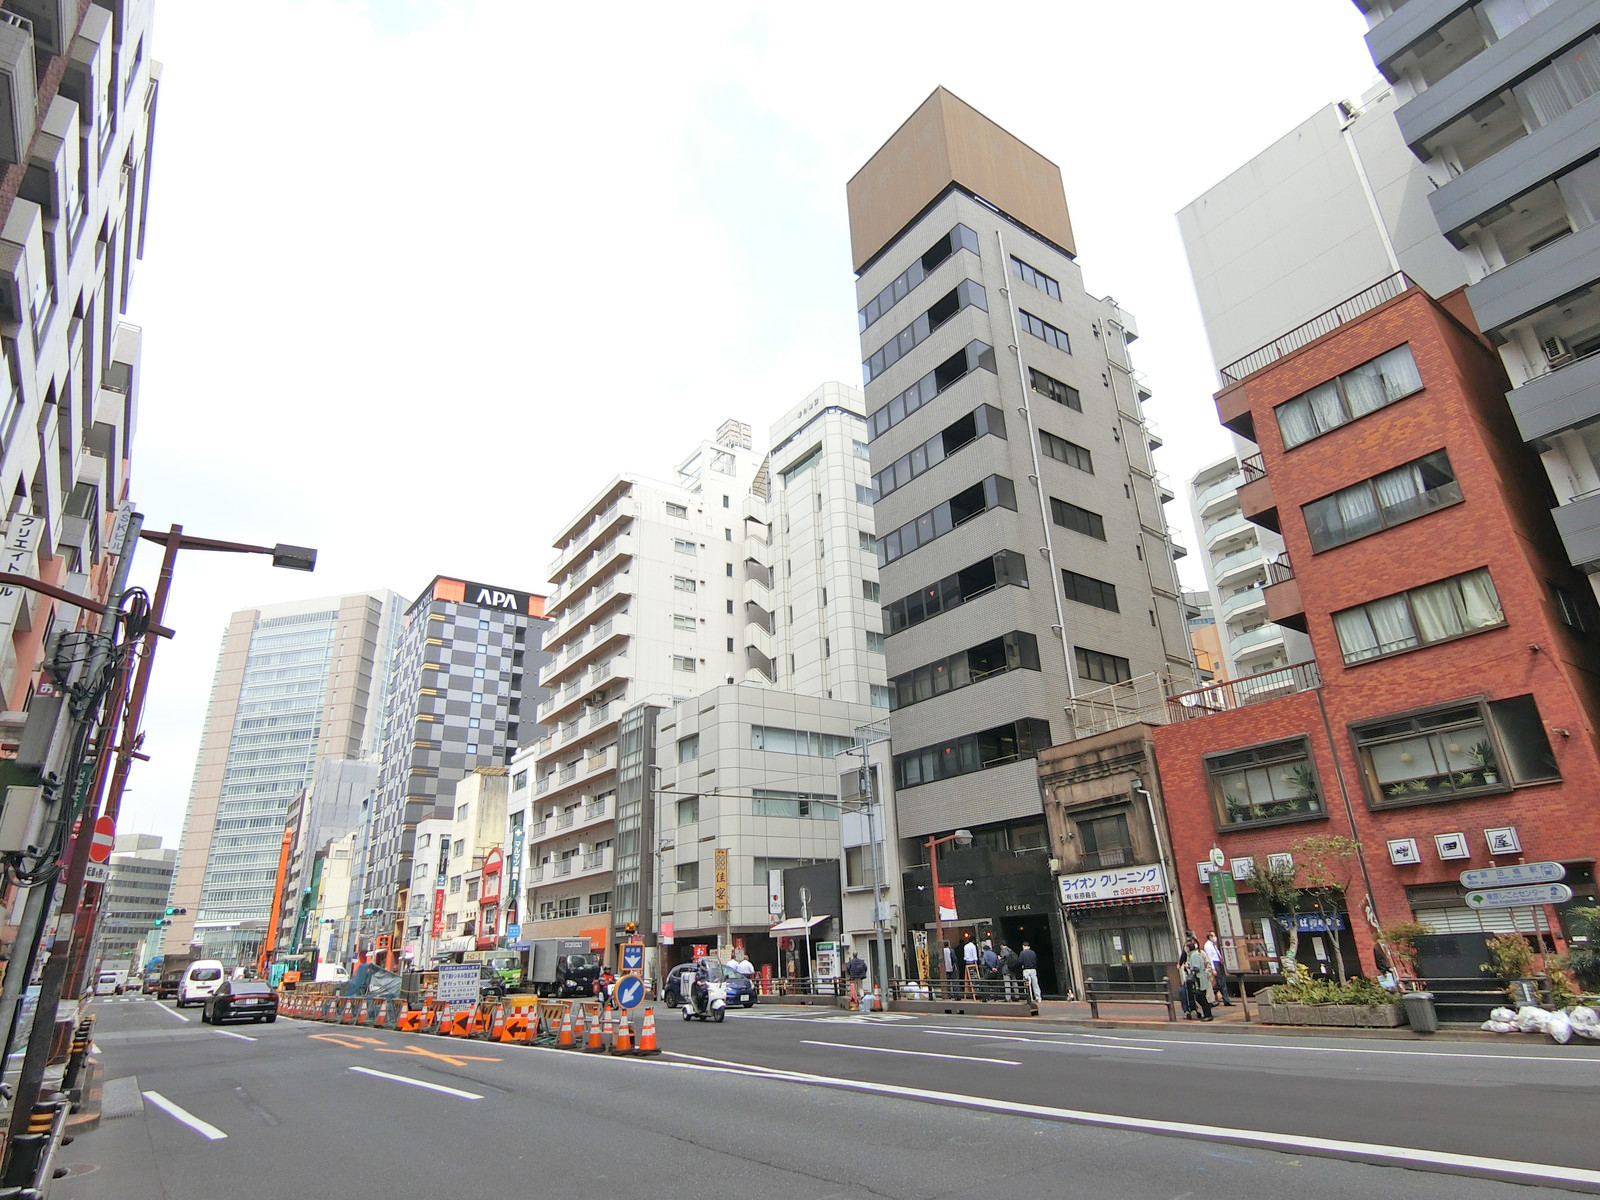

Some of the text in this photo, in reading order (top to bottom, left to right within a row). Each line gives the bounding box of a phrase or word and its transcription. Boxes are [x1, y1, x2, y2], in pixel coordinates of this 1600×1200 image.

[476, 588, 518, 610] APA
[1062, 868, 1157, 891] ライオン クリーニング
